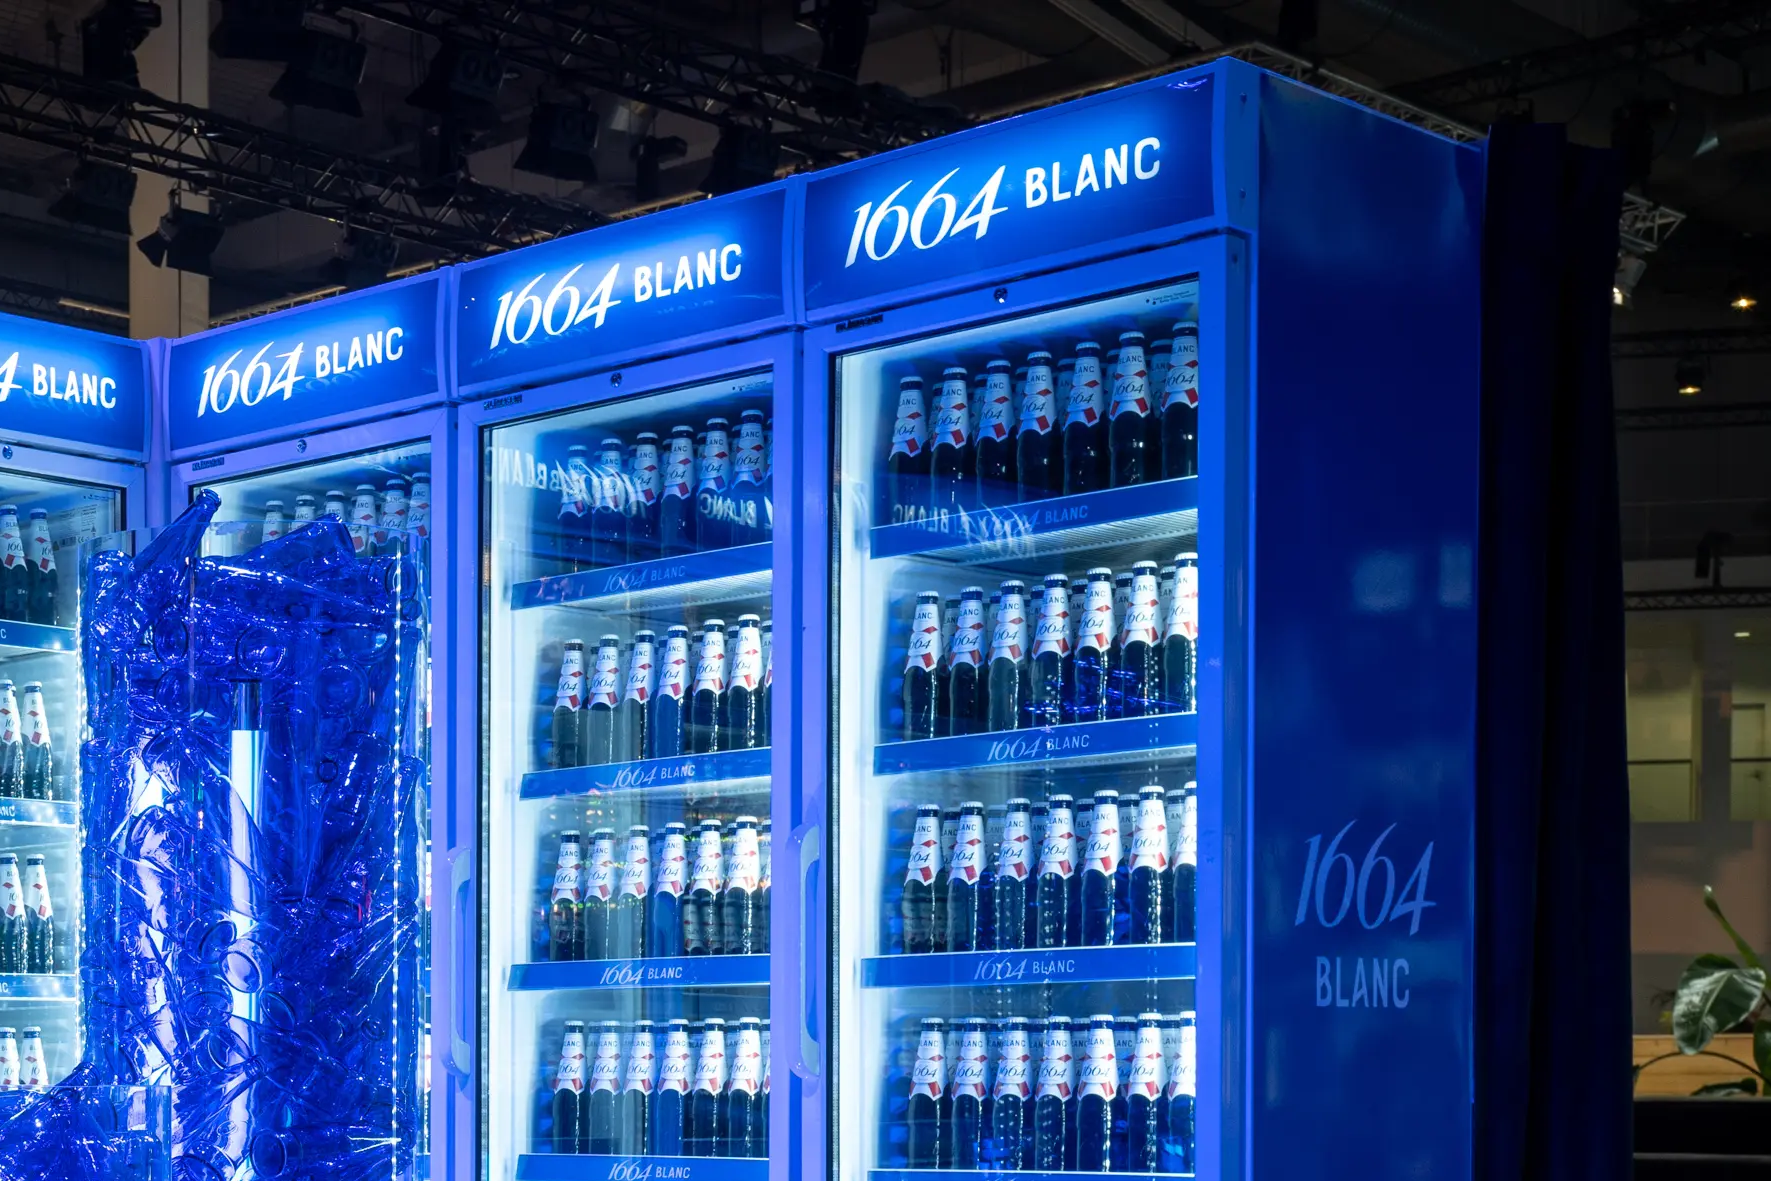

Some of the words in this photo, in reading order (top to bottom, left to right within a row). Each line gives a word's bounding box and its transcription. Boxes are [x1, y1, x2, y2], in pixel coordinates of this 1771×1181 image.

[846, 166, 1006, 266] 1664
[1026, 138, 1159, 208] BLANC
[491, 263, 623, 348] 1664
[633, 244, 741, 302] BLANC
[199, 342, 304, 416] 1664
[316, 328, 402, 378] BLANC
[33, 363, 115, 408] BLANC
[1045, 505, 1088, 524] BLANC
[651, 565, 685, 582] BLANC
[1038, 623, 1065, 635] 664
[988, 736, 1042, 762] 1664
[1047, 734, 1090, 751] BLANC
[612, 766, 658, 789] 1664
[660, 764, 696, 780] BLANC
[561, 849, 579, 858] LANC
[557, 873, 578, 884] 664
[1295, 819, 1437, 936] 1664
[600, 963, 646, 985] 1664
[648, 967, 682, 980] BLANC
[974, 956, 1029, 981] 1664
[1033, 960, 1075, 974] BLANC
[1316, 956, 1410, 1008] BLANC
[595, 1063, 616, 1073] 664
[608, 1159, 652, 1181] 1664
[656, 1167, 690, 1179] BLANC
